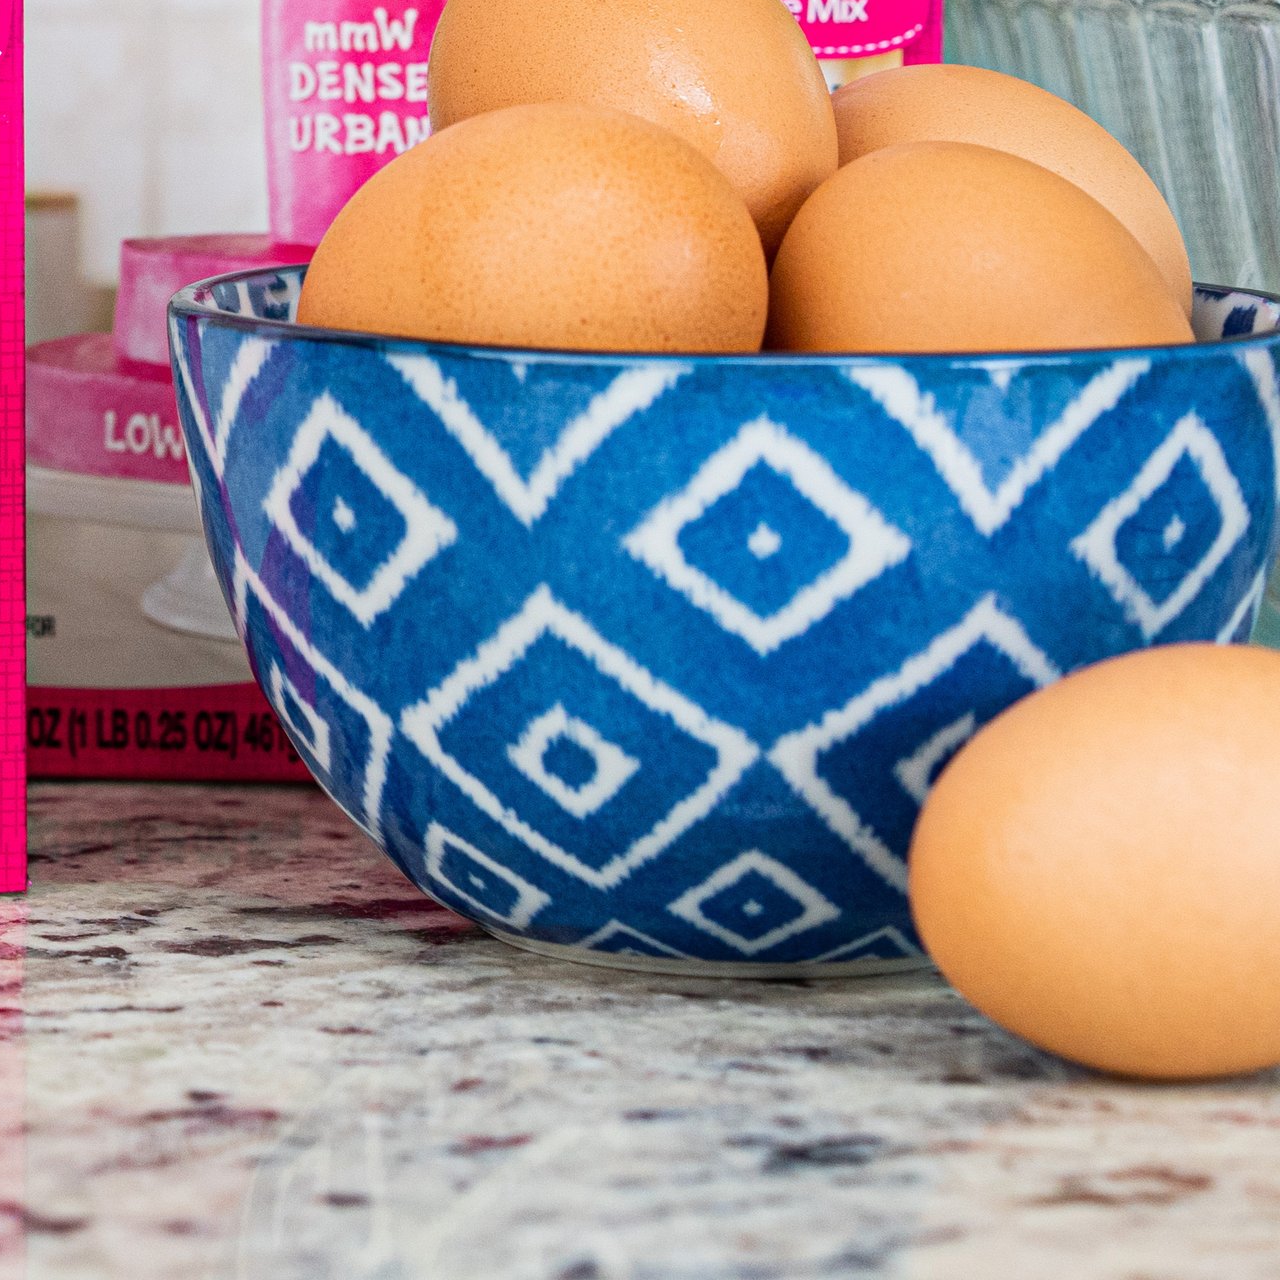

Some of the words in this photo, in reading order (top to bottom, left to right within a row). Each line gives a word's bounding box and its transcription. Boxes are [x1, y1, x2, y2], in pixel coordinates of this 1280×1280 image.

[303, 7, 419, 53] mmW
[290, 61, 428, 103] DENSE
[95, 708, 130, 749] LB
